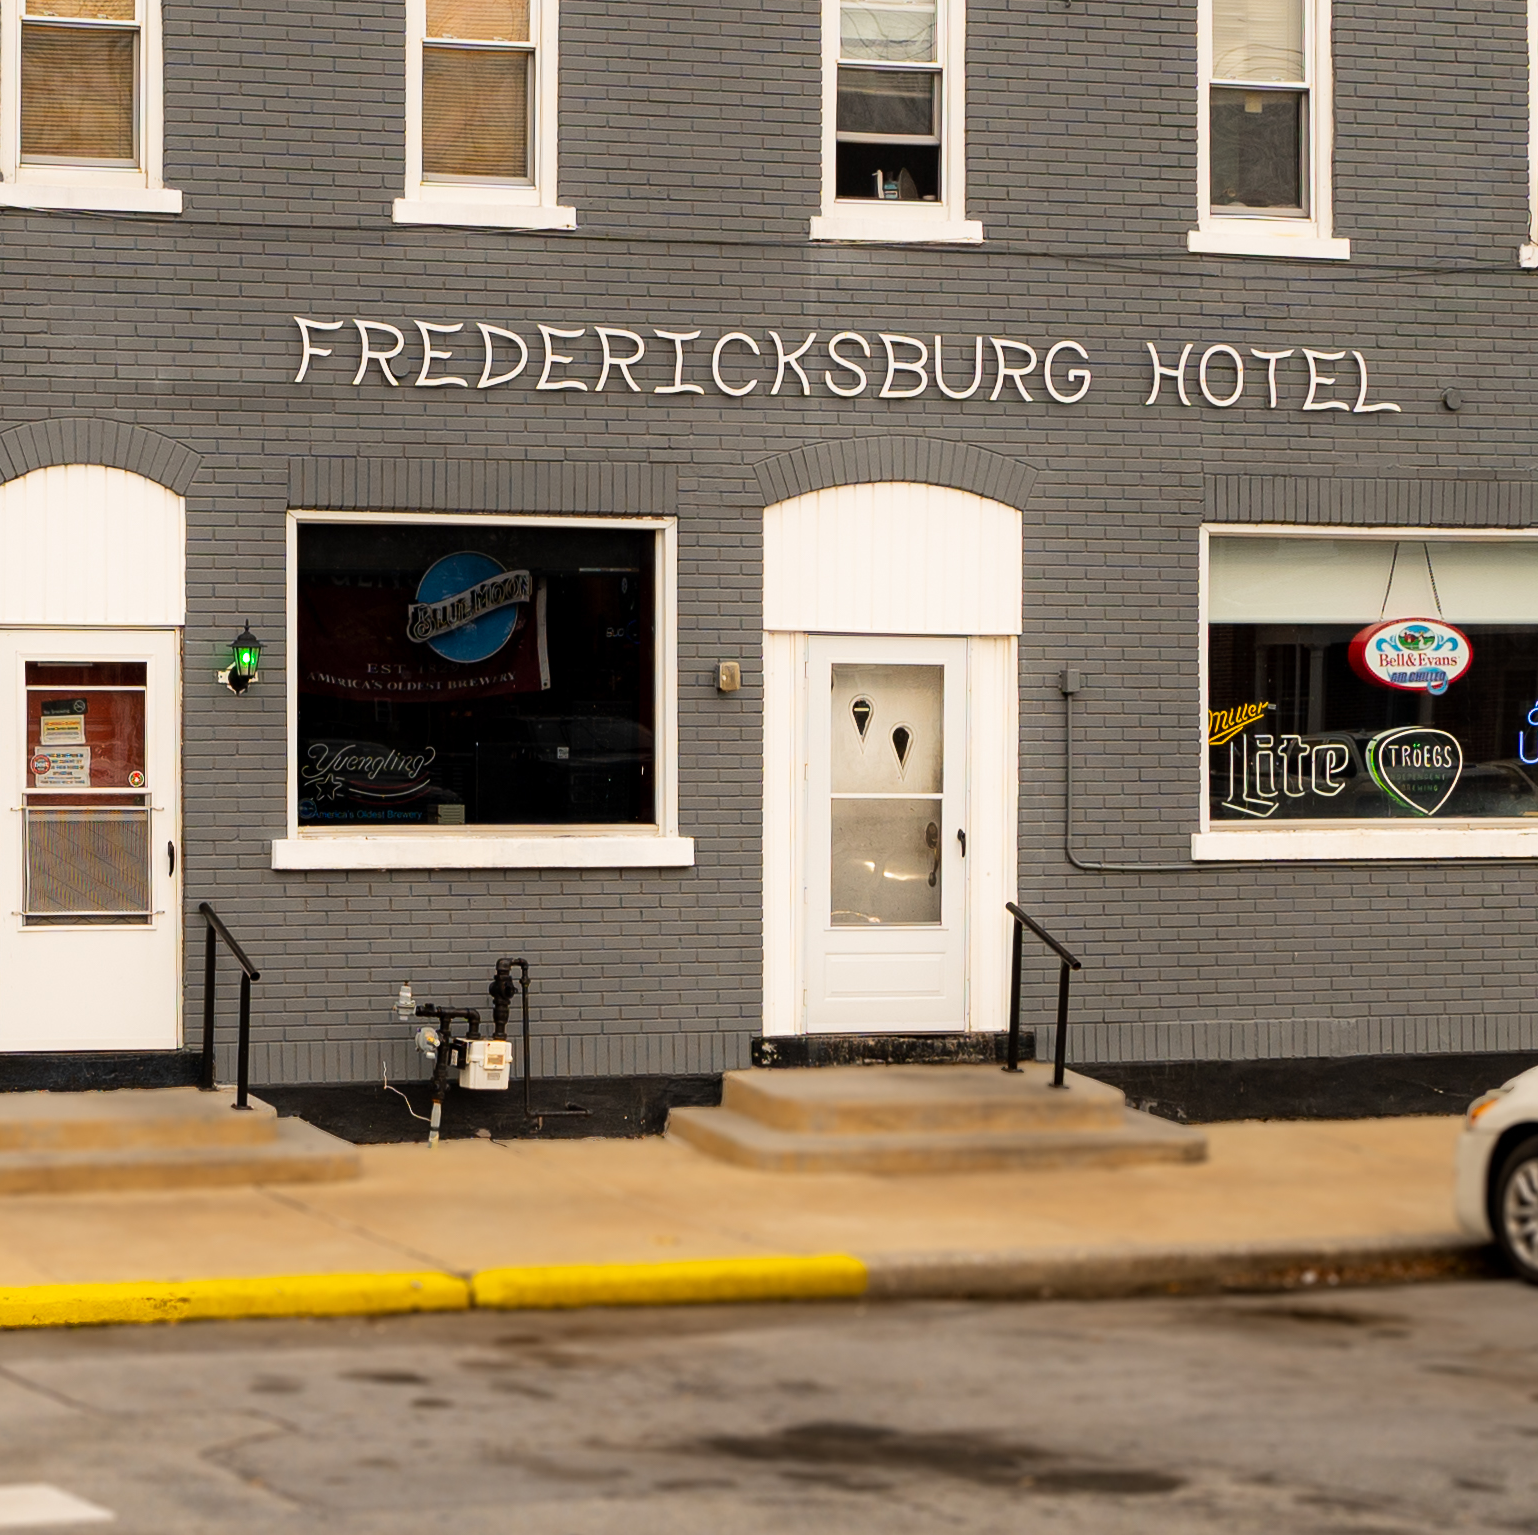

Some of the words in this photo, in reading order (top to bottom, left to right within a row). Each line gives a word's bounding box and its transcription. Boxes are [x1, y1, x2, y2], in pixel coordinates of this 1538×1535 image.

[293, 315, 1092, 404] FREDERICKSBURG
[1145, 342, 1402, 413] HOTEL
[414, 602, 473, 638] BLUE
[472, 574, 533, 613] MOON
[386, 680, 444, 691] OLDEST
[447, 670, 518, 691] BREWERY
[301, 742, 436, 780] Yuengling
[1221, 733, 1350, 818] Lite
[356, 809, 385, 819] Oldest
[387, 809, 424, 821] Brewery
